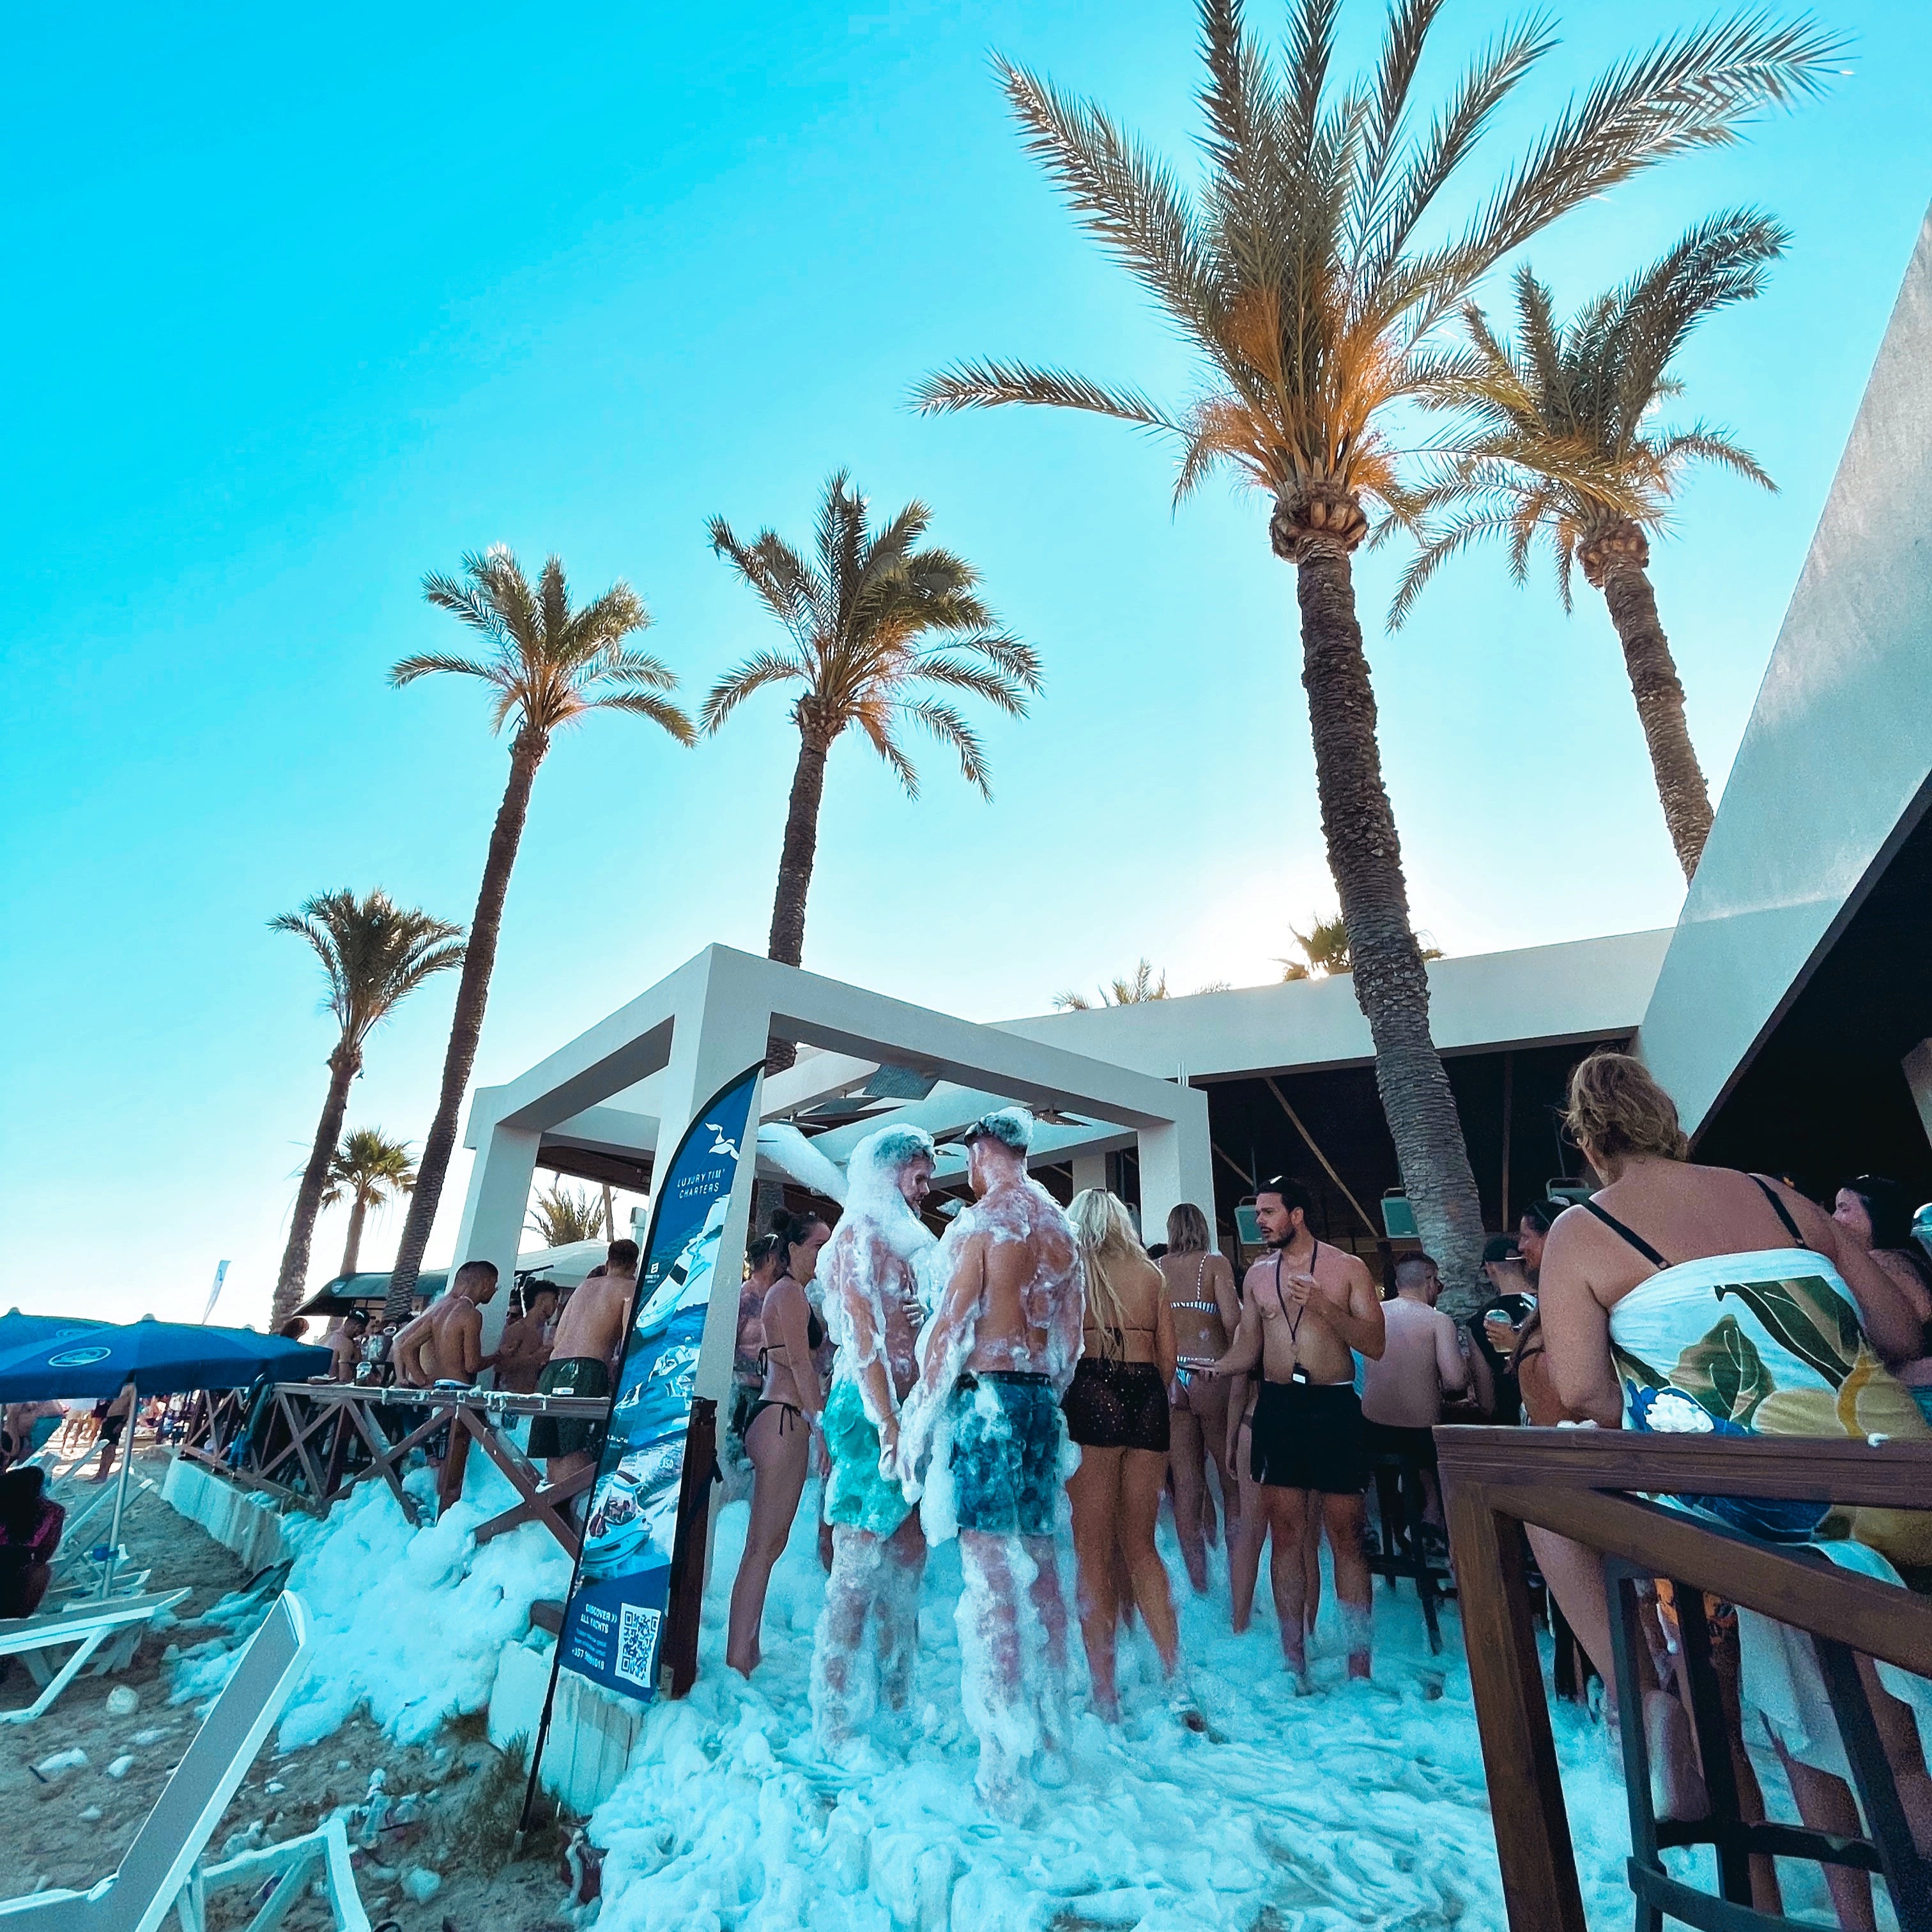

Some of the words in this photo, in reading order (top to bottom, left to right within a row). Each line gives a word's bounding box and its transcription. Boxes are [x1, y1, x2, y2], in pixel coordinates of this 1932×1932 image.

[677, 1172, 707, 1188] LUXURY
[679, 1182, 719, 1199] CHARTERS
[585, 1603, 611, 1621] DISCOVER
[580, 1613, 589, 1625] ALL
[590, 1617, 609, 1634] YACHTS
